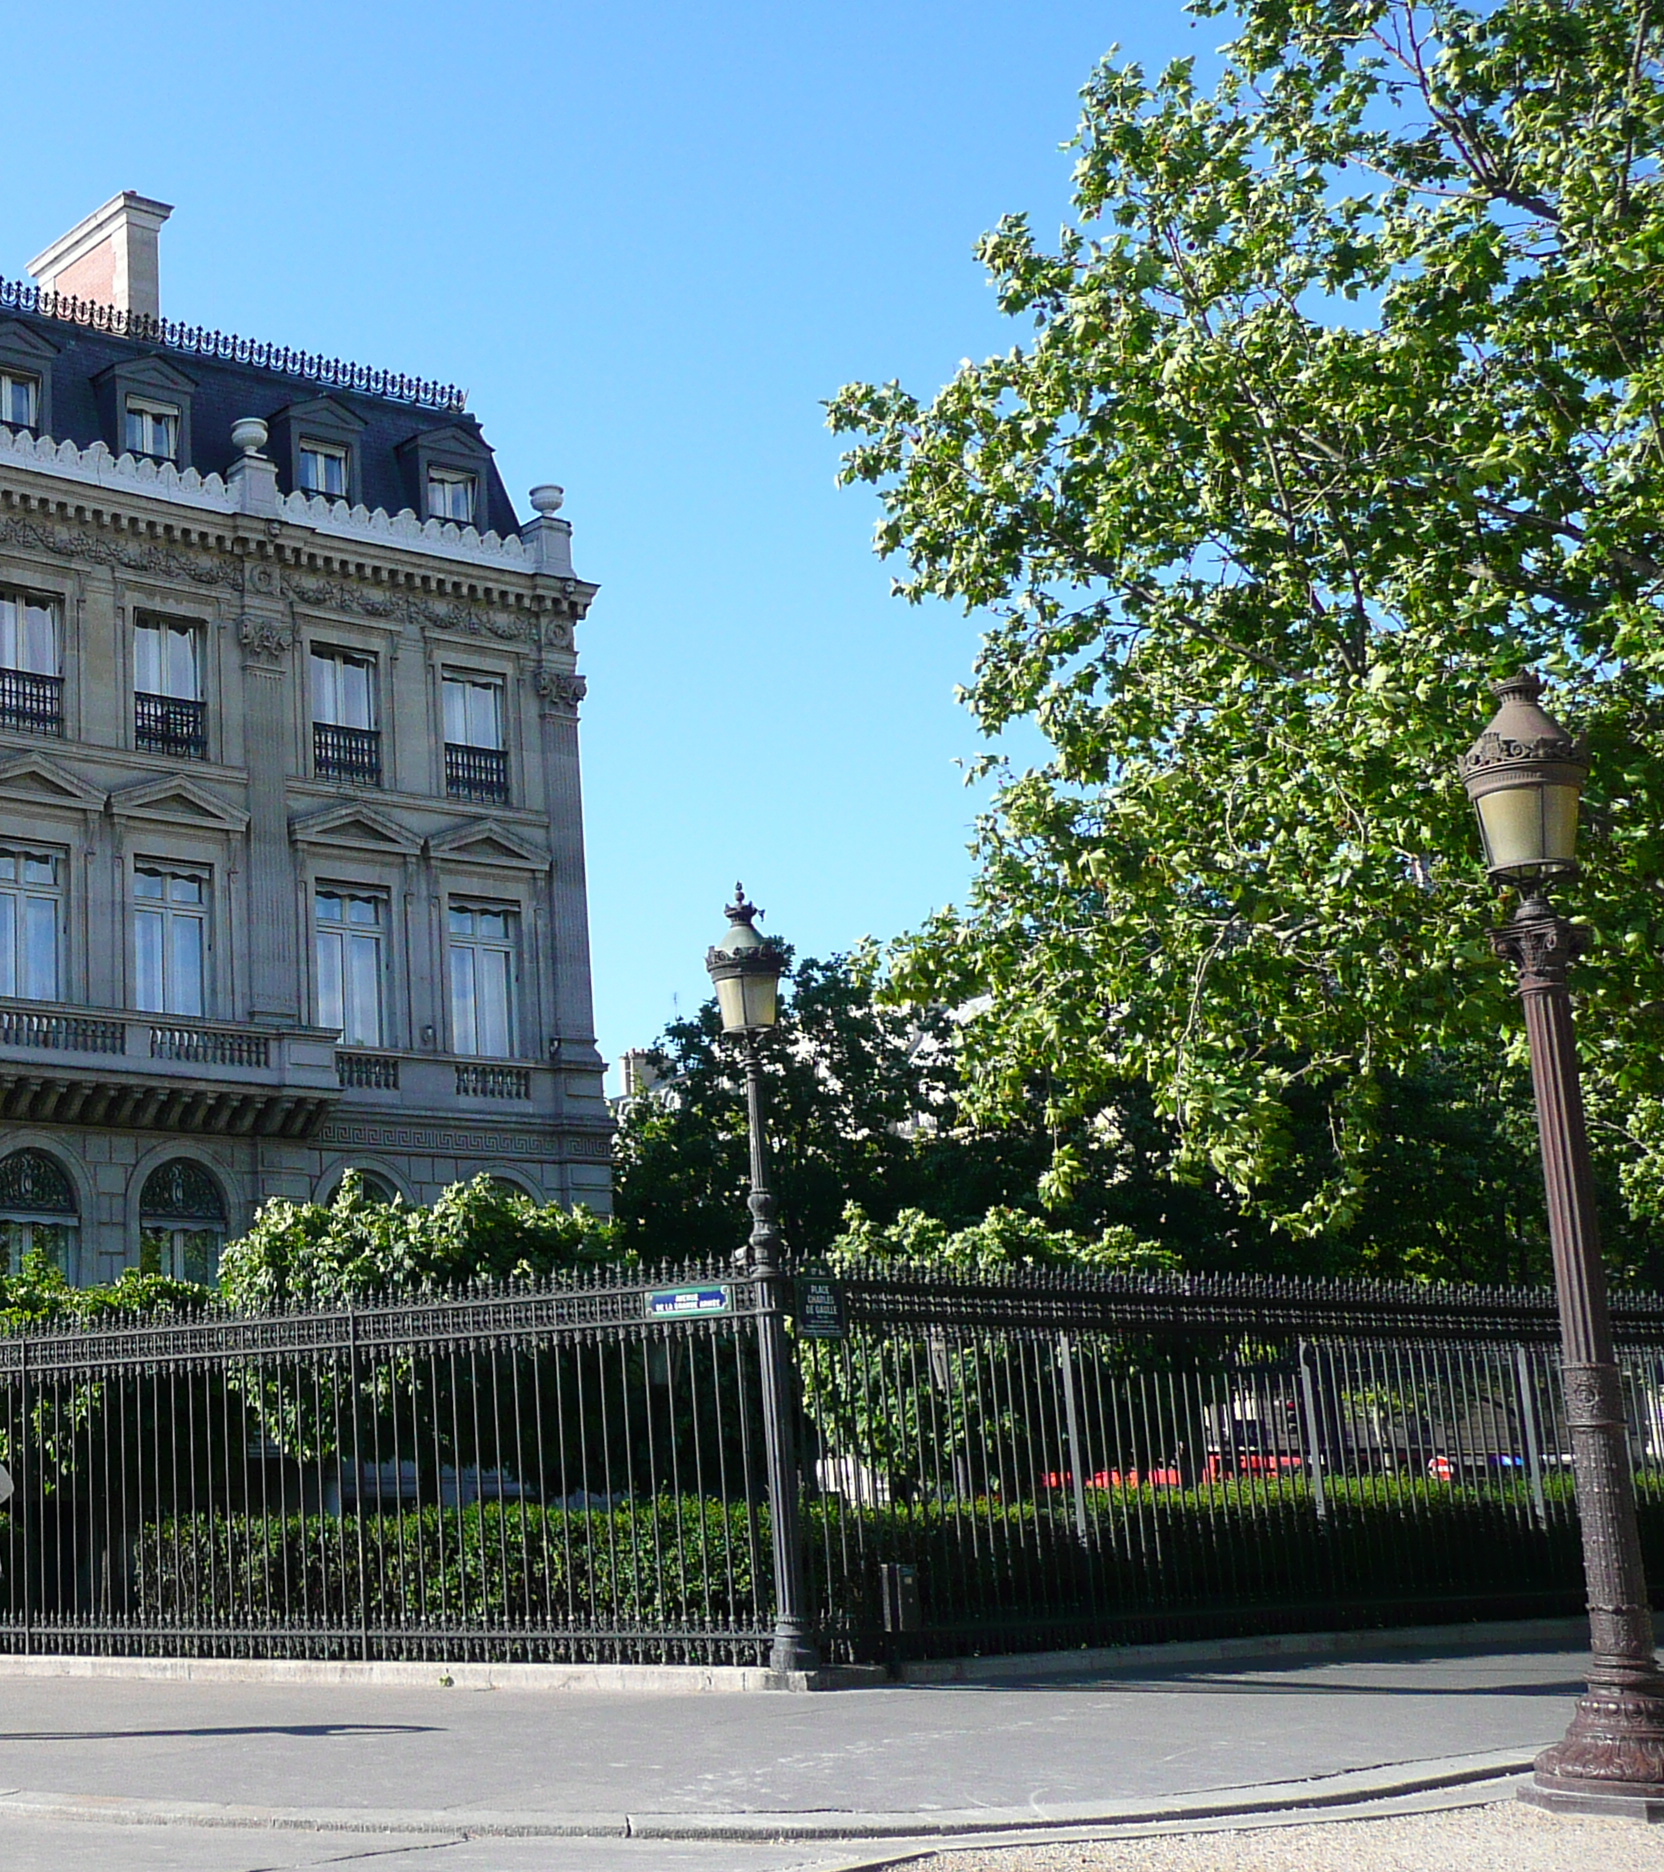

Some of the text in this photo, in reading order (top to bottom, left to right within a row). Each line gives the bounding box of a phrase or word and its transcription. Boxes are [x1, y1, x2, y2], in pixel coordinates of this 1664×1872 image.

[810, 1284, 830, 1294] PLACE
[807, 1295, 835, 1304] CHARLES
[665, 1303, 673, 1311] LA
[805, 1305, 838, 1314] DE GAULLE
